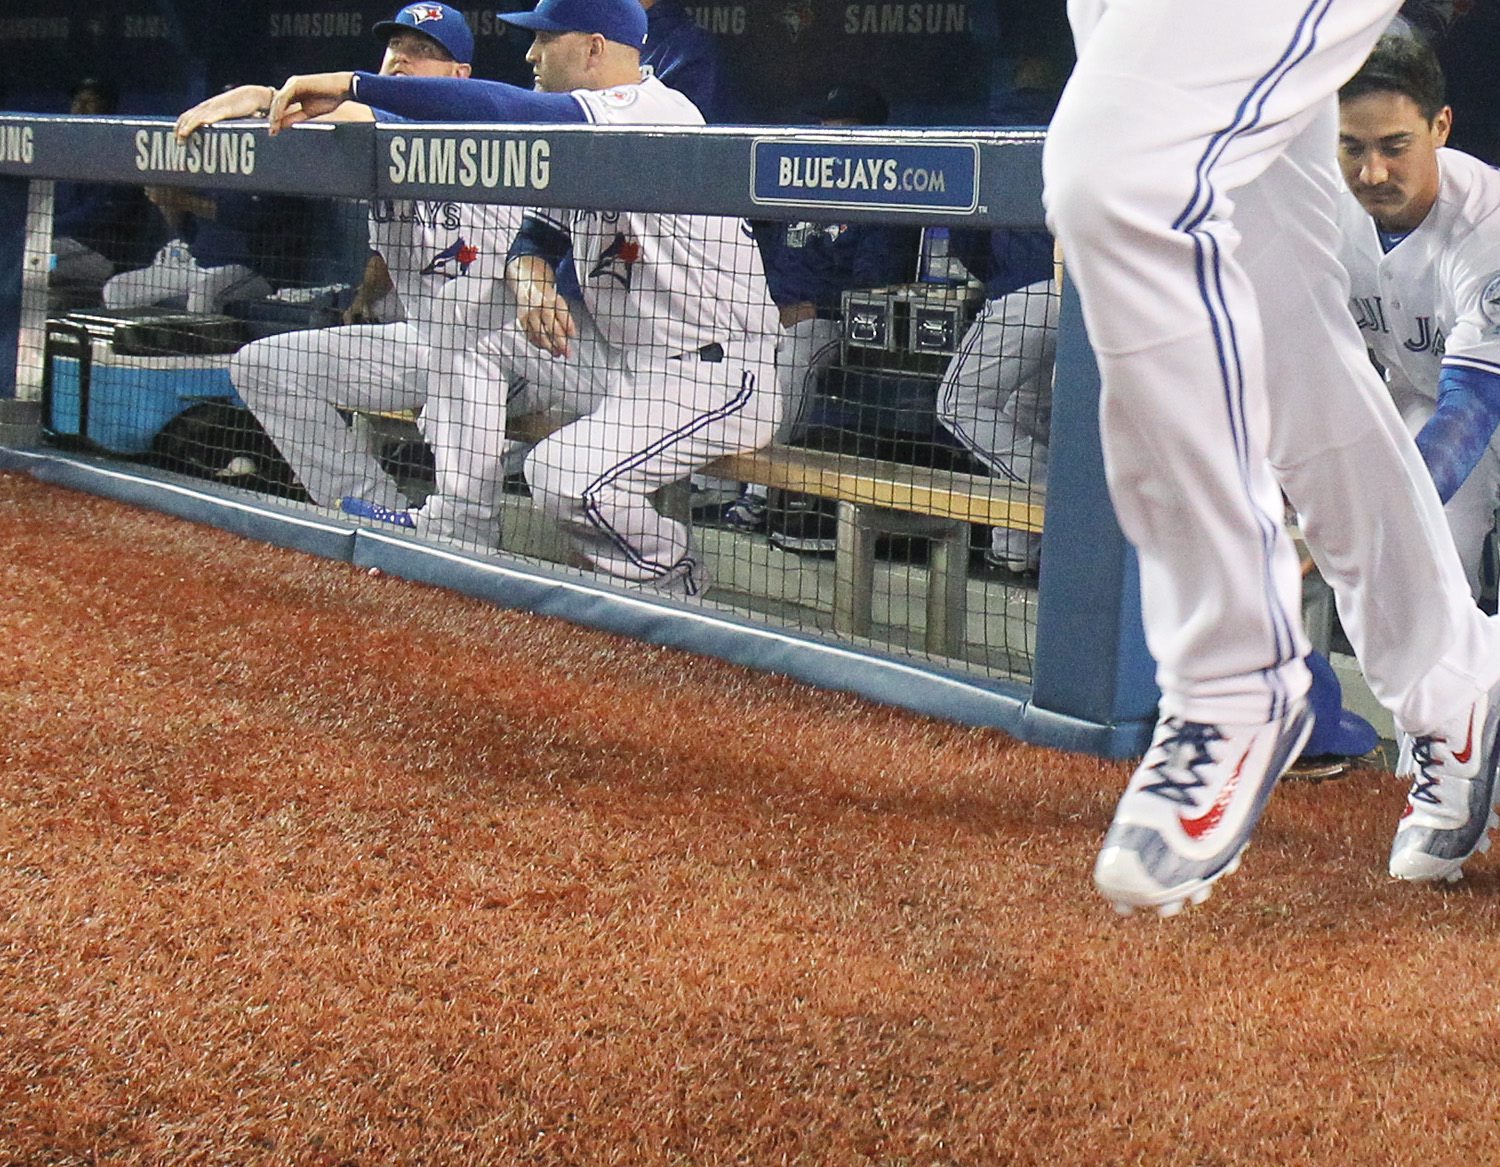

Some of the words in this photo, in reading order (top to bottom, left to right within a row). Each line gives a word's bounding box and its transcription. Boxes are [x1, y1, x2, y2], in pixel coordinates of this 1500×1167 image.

[845, 3, 966, 33] SAMSUN
[135, 129, 256, 175] SAMSUNG
[389, 139, 550, 189] SAMSUNG
